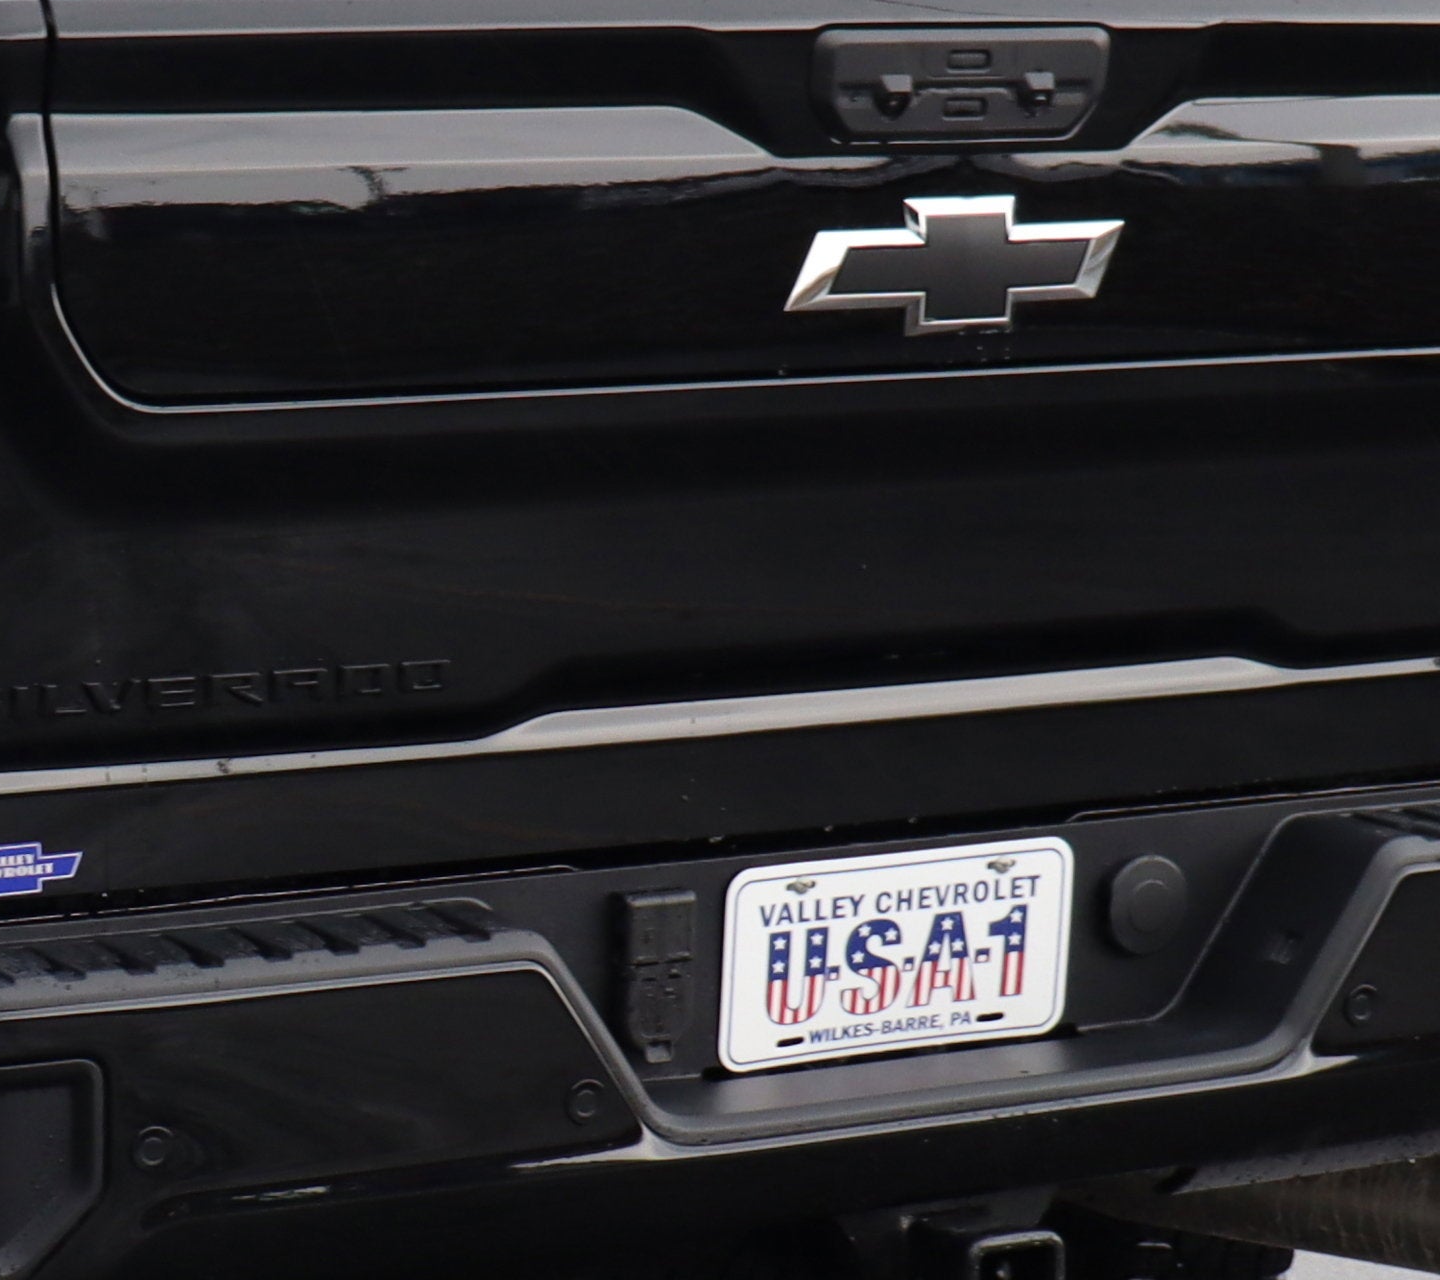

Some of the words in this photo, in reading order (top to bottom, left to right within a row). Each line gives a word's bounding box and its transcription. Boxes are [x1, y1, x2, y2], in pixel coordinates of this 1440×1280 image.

[759, 894, 865, 928] VALLEY
[875, 875, 1041, 914] CHEVROLET
[809, 1013, 945, 1044] WILKES-BARRE,
[950, 1011, 972, 1026] PA
